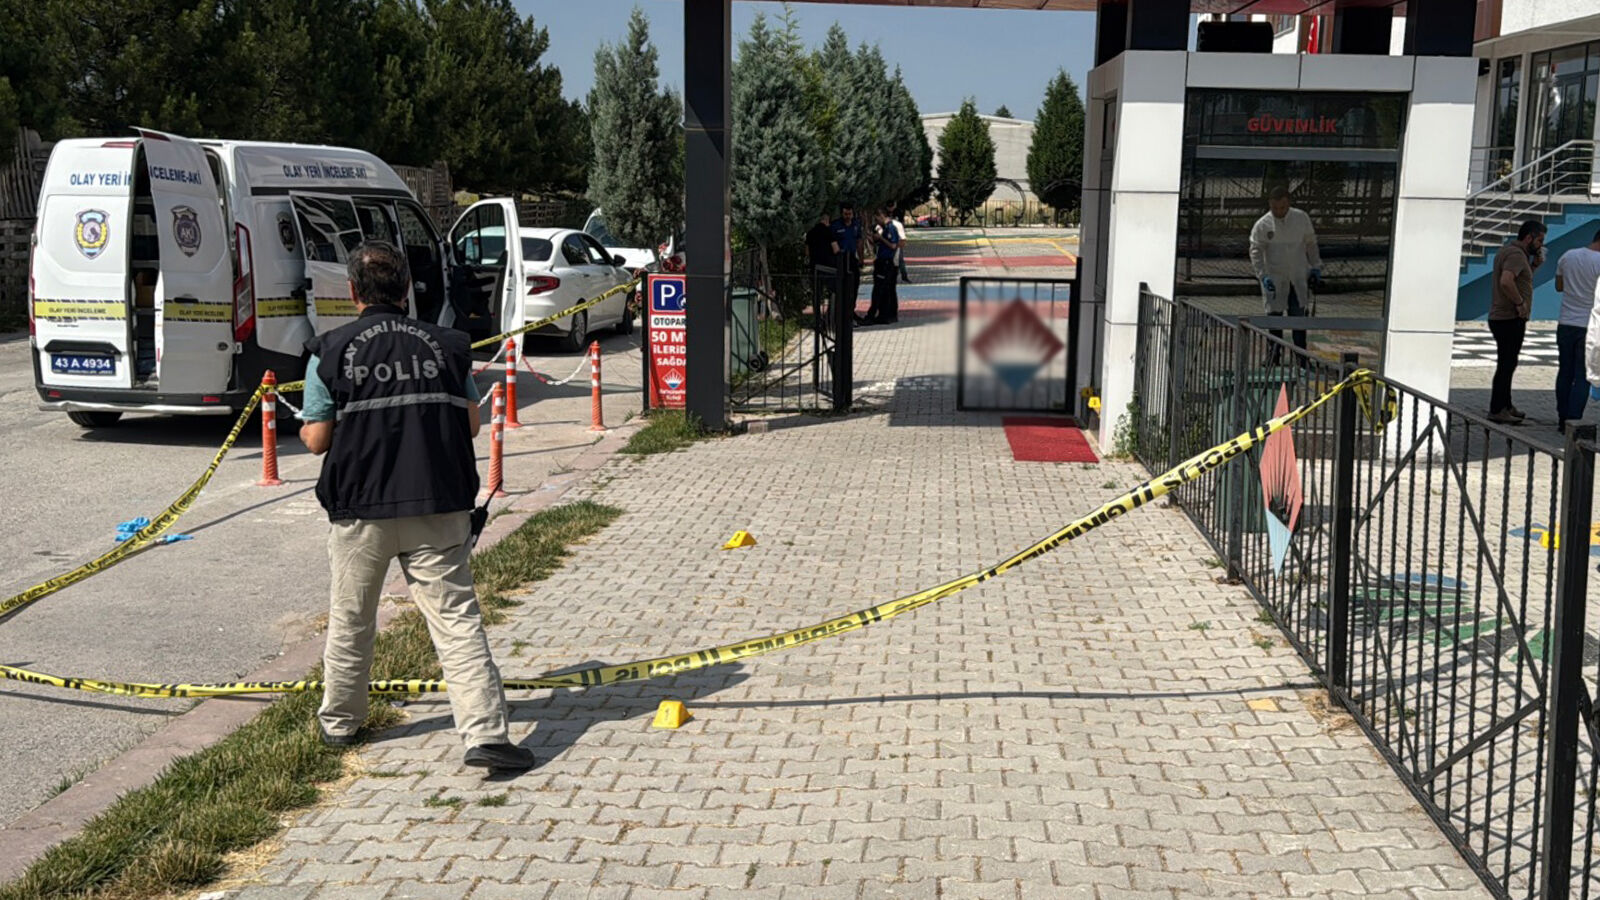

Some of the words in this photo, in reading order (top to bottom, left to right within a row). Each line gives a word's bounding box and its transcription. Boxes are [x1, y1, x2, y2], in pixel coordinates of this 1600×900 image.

[1247, 114, 1337, 133] GÜVENLİK
[283, 164, 303, 178] OLAY
[70, 173, 96, 186] OLAY
[99, 171, 121, 186] YERİ
[661, 284, 676, 306] P
[653, 317, 686, 327] OTOPAR
[652, 331, 667, 343] 50
[343, 342, 358, 380] OLAY
[355, 320, 388, 343] YERİ
[653, 344, 686, 355] İLERİD
[55, 358, 69, 368] 43
[71, 358, 80, 368] A
[82, 359, 111, 369] 4934
[354, 355, 439, 386] POLİS
